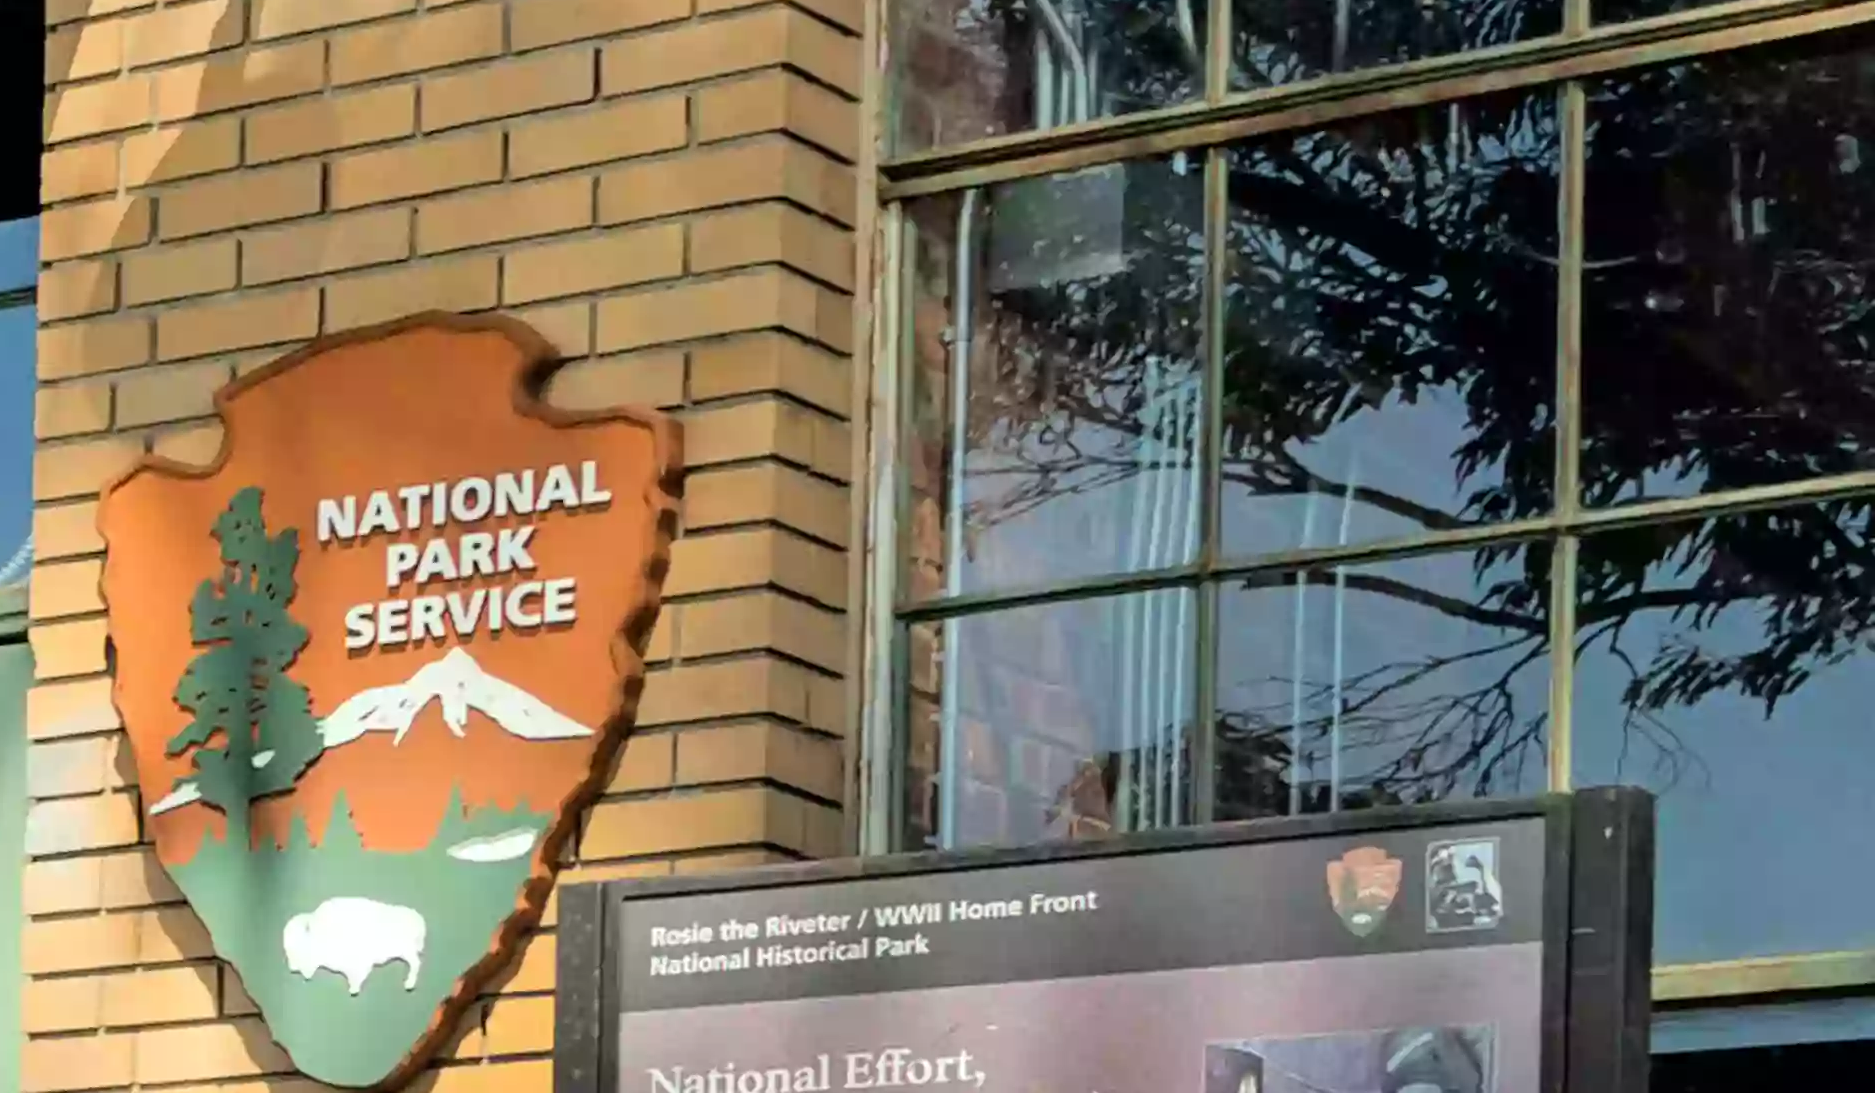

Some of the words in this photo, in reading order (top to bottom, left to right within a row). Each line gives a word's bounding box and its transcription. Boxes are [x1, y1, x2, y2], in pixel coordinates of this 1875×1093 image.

[317, 461, 612, 543] NATIONAL
[386, 526, 537, 587] PARK
[344, 578, 577, 651] SERVICE
[650, 926, 713, 947] Rosie
[720, 921, 759, 941] the
[765, 913, 851, 938] Riveter
[856, 909, 869, 931] /
[874, 902, 942, 928] WWII
[949, 896, 1023, 922] Home
[1029, 891, 1098, 915] Front
[650, 950, 750, 976] National
[756, 937, 869, 969] Historical
[874, 933, 930, 957] Park
[646, 1054, 831, 1093] National
[843, 1047, 987, 1089] Effort,
